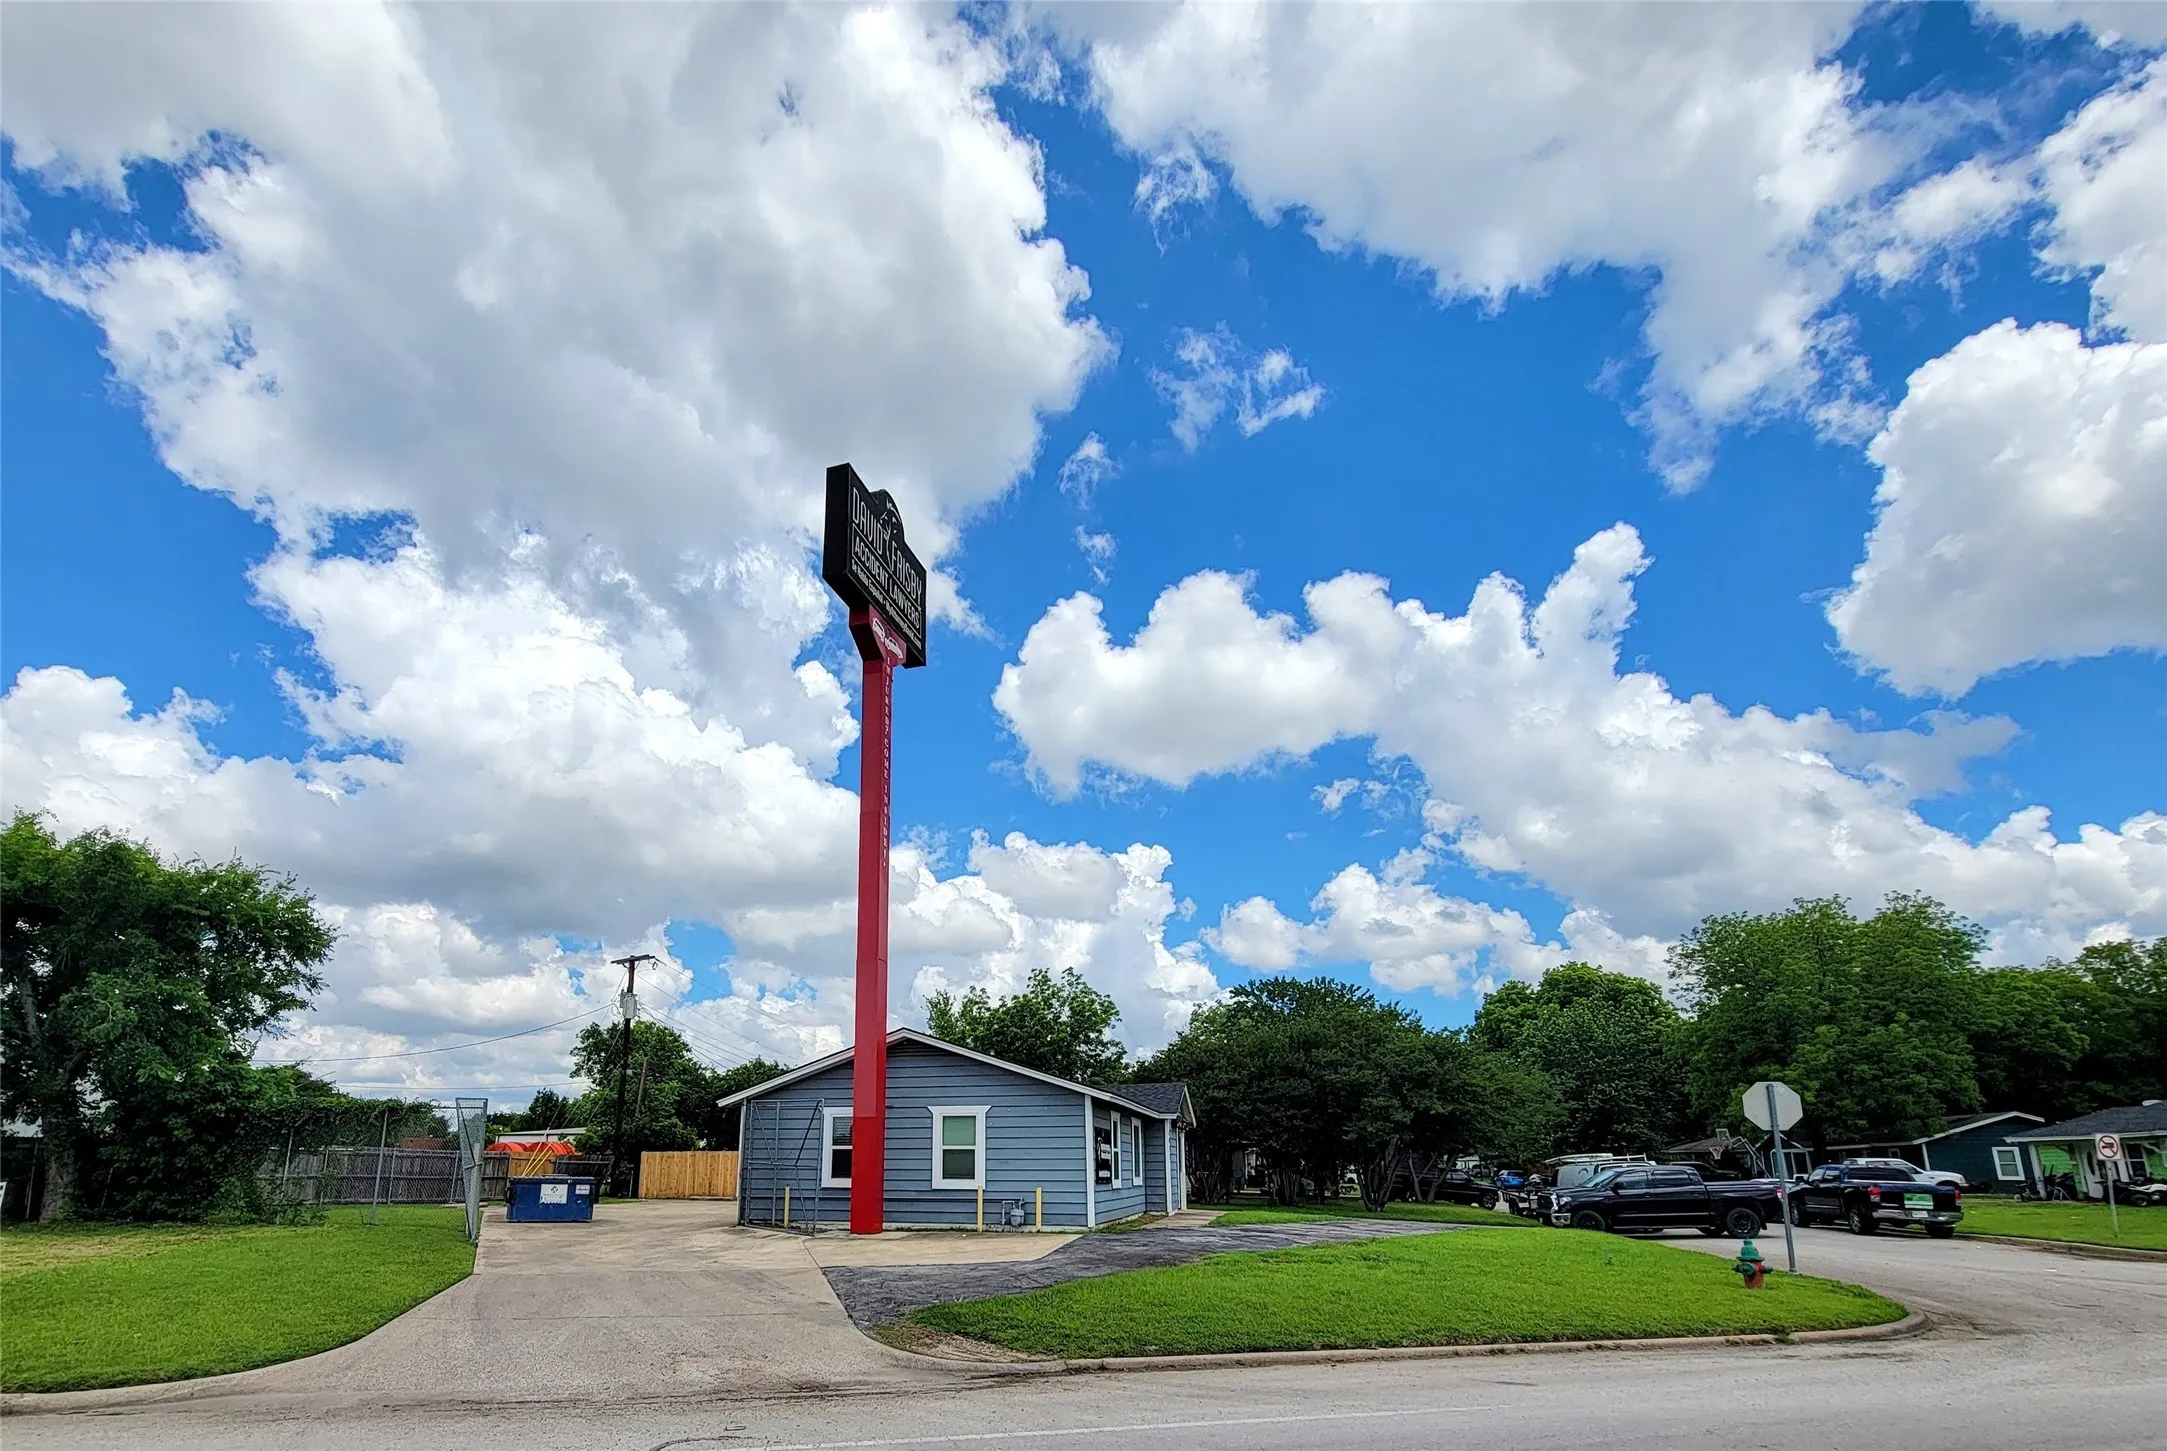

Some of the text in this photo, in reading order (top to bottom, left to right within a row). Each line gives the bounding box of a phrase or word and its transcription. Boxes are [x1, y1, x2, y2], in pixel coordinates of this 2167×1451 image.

[853, 487, 922, 607] DAVID FRISBY
[855, 536, 920, 629] ACCIDENT LAWYERS
